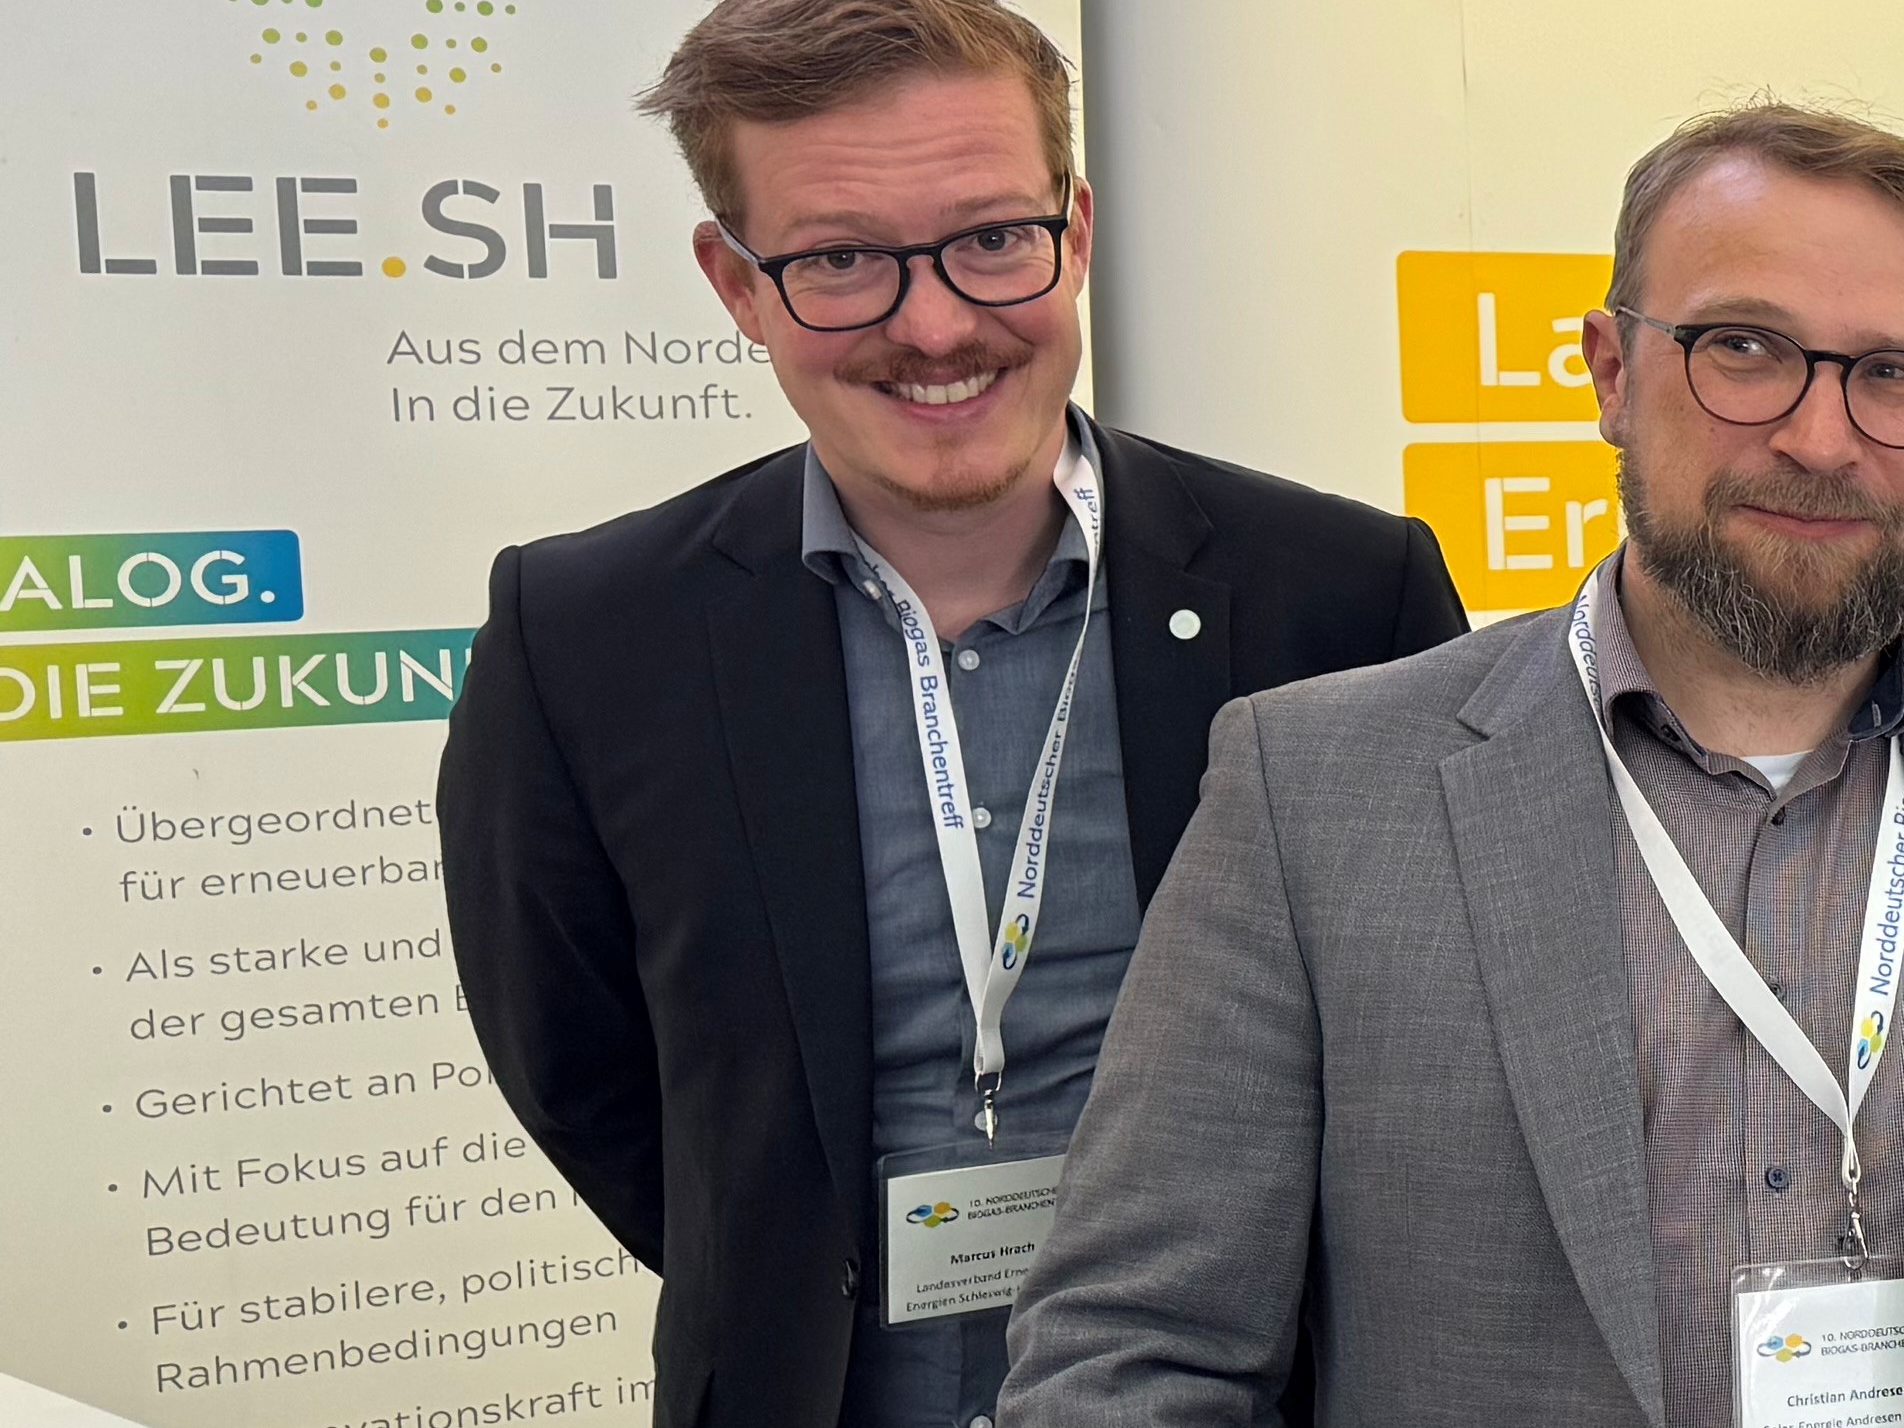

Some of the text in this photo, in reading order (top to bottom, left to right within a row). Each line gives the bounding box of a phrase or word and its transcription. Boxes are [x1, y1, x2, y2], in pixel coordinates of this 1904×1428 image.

[74, 172, 617, 280] LEE.SH
[387, 330, 482, 366] Aus
[498, 328, 606, 366] dem
[393, 384, 752, 422] In die Zukunft.
[0, 550, 276, 612] ALOG.
[155, 647, 471, 715] ZUKUN
[919, 675, 964, 830] Branchentreff
[1017, 728, 1066, 900] Norddeutscher
[119, 869, 185, 902] für
[126, 928, 442, 982] Als starke und
[130, 1007, 204, 1040] der
[220, 989, 440, 1042] gesamten
[136, 1074, 352, 1119] Gerichtet
[367, 1068, 416, 1096] an
[143, 1132, 526, 1199] Mit Fokus auf die
[146, 1203, 390, 1256] Bedeutung
[405, 1194, 466, 1226] für
[481, 1186, 556, 1217] den
[916, 1270, 1002, 1294] Landesverband
[950, 1249, 996, 1265] Marcus
[153, 1247, 639, 1335] Für stabilere, politisch
[906, 1297, 956, 1313] Energien
[157, 1309, 616, 1393] Rahmenbedingungen
[1786, 1390, 1846, 1408] Christian
[1846, 1409, 1902, 1427] Andresen
